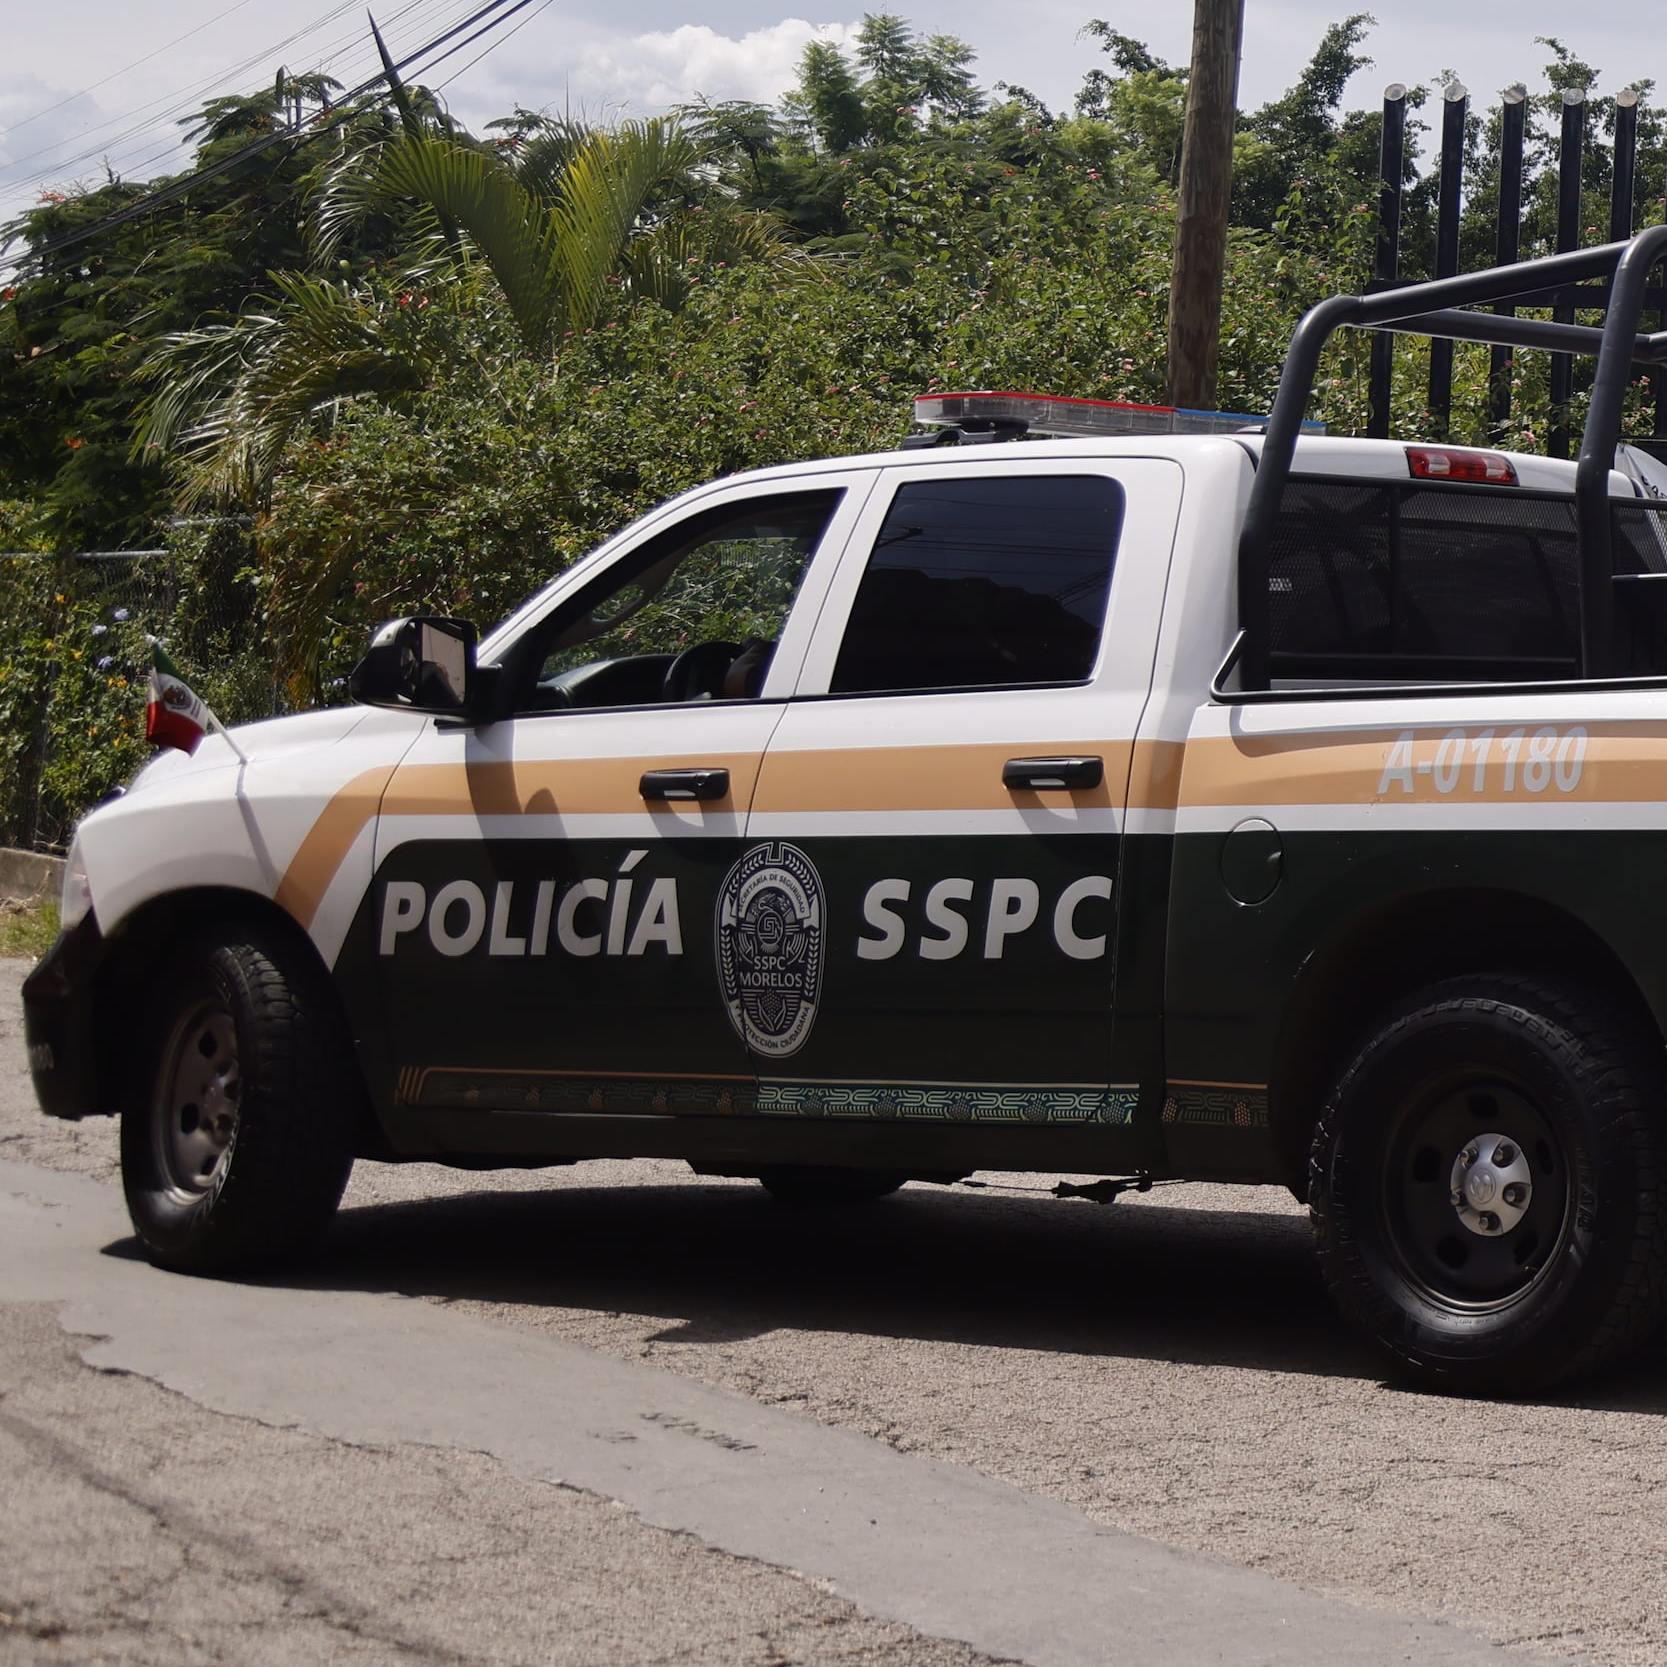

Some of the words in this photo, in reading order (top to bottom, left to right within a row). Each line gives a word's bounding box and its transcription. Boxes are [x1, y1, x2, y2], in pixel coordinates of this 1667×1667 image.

[1377, 726, 1588, 795] A-01180
[379, 850, 683, 957] POLICÍA
[768, 873, 778, 882] DE
[779, 874, 806, 914] SEGURIDAD
[857, 876, 1112, 962] SSPC
[739, 971, 803, 988] MORELOS
[754, 955, 786, 971] SSPC
[737, 1012, 779, 1049] POTECCIÓN
